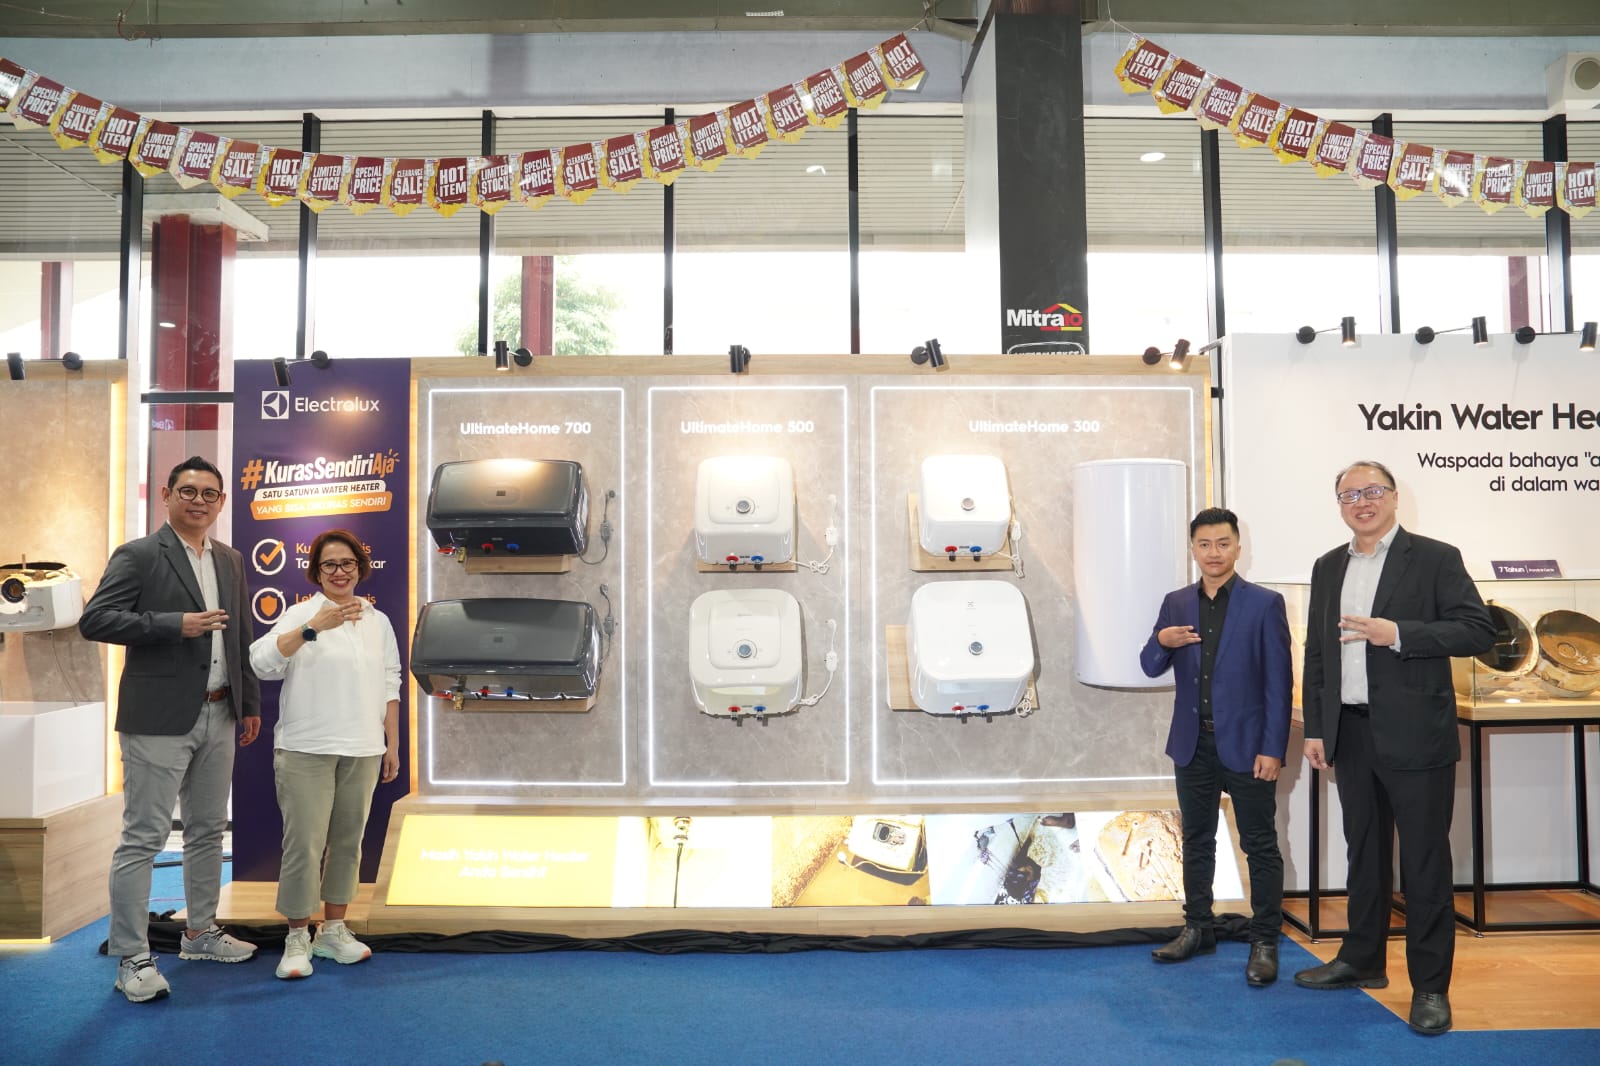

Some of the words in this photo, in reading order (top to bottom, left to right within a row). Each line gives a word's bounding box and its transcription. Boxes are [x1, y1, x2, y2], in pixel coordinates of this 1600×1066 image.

[885, 40, 911, 67] HOT
[1135, 49, 1165, 69] HOT
[849, 60, 875, 82] LIMITED
[893, 53, 919, 77] ITEM
[1129, 62, 1159, 80] ITEM
[810, 76, 837, 98] SPECIAL
[854, 71, 881, 96] STOCK
[1171, 71, 1200, 87] LIMITED
[31, 85, 61, 101] SPECIAL
[1166, 81, 1197, 100] STOCK
[1210, 87, 1238, 103] SPECIAL
[23, 95, 56, 116] PRICE
[772, 94, 796, 111] CLEARANCE
[815, 86, 842, 113] PRICE
[1205, 97, 1235, 116] PRICE
[71, 104, 98, 116] CLEARANCE
[774, 101, 805, 127] SALE
[1250, 104, 1276, 117] CLEARANCE
[63, 111, 96, 133] SALE
[107, 117, 137, 136] HOT
[732, 107, 759, 131] HOT
[1242, 112, 1273, 133] SALE
[1286, 118, 1314, 137] HOT
[146, 132, 176, 146] LIMITED
[692, 121, 720, 141] LIMITED
[737, 122, 764, 143] ITEM
[1324, 133, 1353, 146] LIMITED
[103, 132, 132, 148] ITEM
[188, 142, 216, 154] SPECIAL
[651, 131, 677, 151] SPECIAL
[695, 133, 723, 155] STOCK
[1283, 133, 1311, 148] ITEM
[142, 143, 172, 159] STOCK
[229, 151, 255, 160] CLEARANCE
[610, 144, 636, 158] CLEARANCE
[654, 142, 681, 166] PRICE
[1320, 145, 1350, 160] STOCK
[1364, 143, 1391, 156] SPECIAL
[184, 153, 213, 169] PRICE
[272, 159, 300, 175] HOT
[524, 157, 550, 173] SPECIAL
[609, 152, 640, 176] SALE
[1361, 155, 1389, 170] PRICE
[1405, 155, 1431, 164] CLEARANCE
[224, 159, 254, 178] SALE
[313, 165, 341, 177] LIMITED
[355, 166, 382, 178] SPECIAL
[397, 168, 423, 178] CLEARANCE
[440, 166, 466, 186] HOT
[481, 164, 509, 180] LIMITED
[566, 161, 596, 185] SALE
[1400, 162, 1430, 181] SALE
[270, 174, 297, 188] ITEM
[311, 177, 339, 191] STOCK
[353, 177, 381, 194] PRICE
[394, 176, 423, 196] SALE
[481, 175, 509, 194] STOCK
[524, 168, 552, 190] PRICE
[1485, 177, 1511, 193] PRICE
[1526, 172, 1553, 185] LIMITED
[1568, 170, 1594, 188] HOT
[440, 181, 467, 197] ITEM
[1526, 183, 1552, 199] STOCK
[1568, 186, 1595, 200] ITEM
[295, 396, 380, 412] Electrolux
[1357, 403, 1442, 430] Yakin
[1450, 403, 1543, 430] Water
[460, 422, 560, 435] UltimateHome
[564, 422, 592, 434] 700
[681, 420, 783, 434] UltimateHome
[788, 420, 815, 433] 500
[968, 420, 1068, 433] UltimateHome
[1073, 420, 1100, 433] 300
[1417, 452, 1503, 472] Waspada
[1509, 452, 1578, 471] bahaya
[240, 452, 395, 491] #KurasSendiriAja
[262, 490, 283, 499] SATU
[284, 488, 319, 498] SATUNYA
[322, 485, 348, 495] WATER
[350, 482, 380, 492] HEATER
[1489, 476, 1505, 492] di
[1511, 476, 1567, 492] dalam
[256, 505, 283, 515] YANG
[350, 496, 386, 507] SENDIRI
